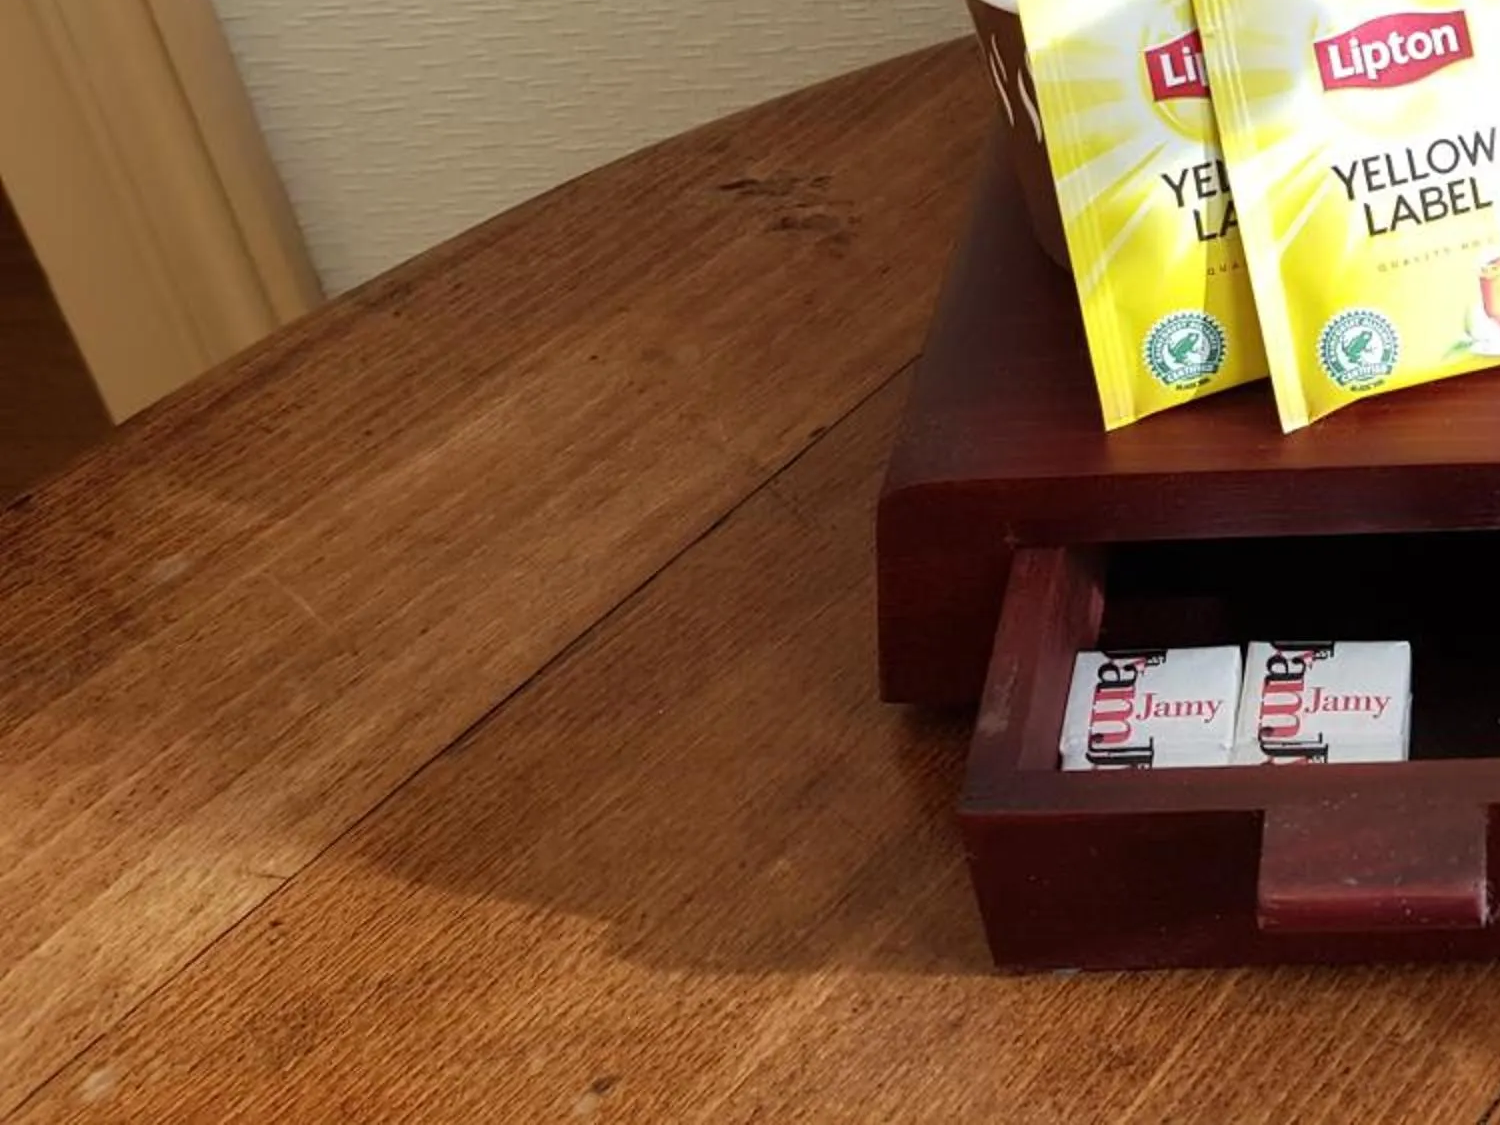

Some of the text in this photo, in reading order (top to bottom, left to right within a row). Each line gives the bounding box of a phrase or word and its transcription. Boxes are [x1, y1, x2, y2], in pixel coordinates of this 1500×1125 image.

[1328, 24, 1460, 80] Lipton
[1331, 126, 1496, 201] YELLOW
[1364, 176, 1493, 237] LABEL
[1136, 687, 1391, 723] Jamy Jamy
